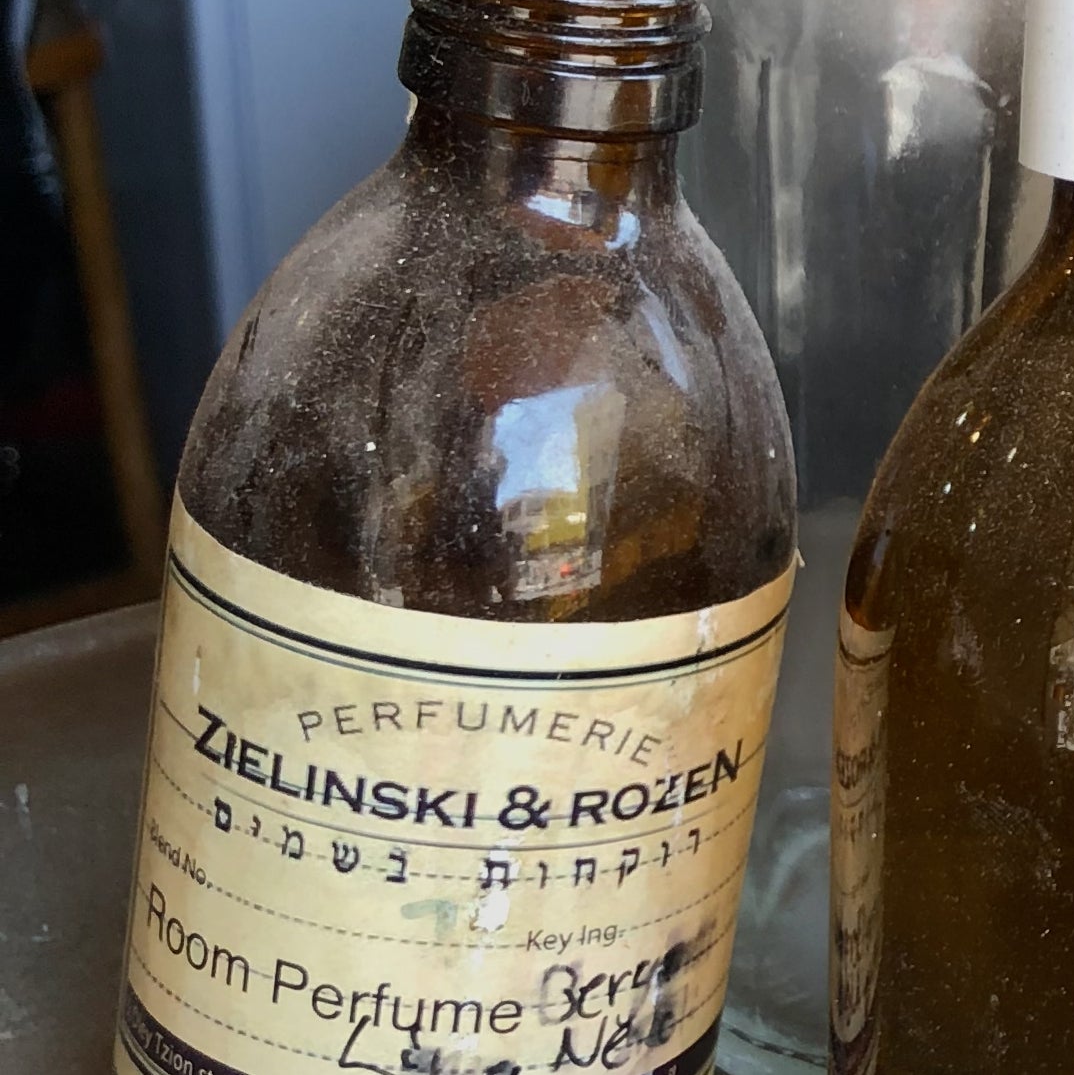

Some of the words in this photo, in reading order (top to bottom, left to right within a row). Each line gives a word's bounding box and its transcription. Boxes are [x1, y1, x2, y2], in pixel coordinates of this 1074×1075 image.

[296, 700, 663, 767] PERFUMERIE
[194, 704, 478, 829] ZIELINSKI
[497, 784, 552, 831] &
[568, 737, 743, 828] ROZEN
[148, 882, 249, 994] Room
[272, 958, 523, 1034] Perfume
[526, 929, 574, 955] Key
[155, 1031, 194, 1075] Tzion
